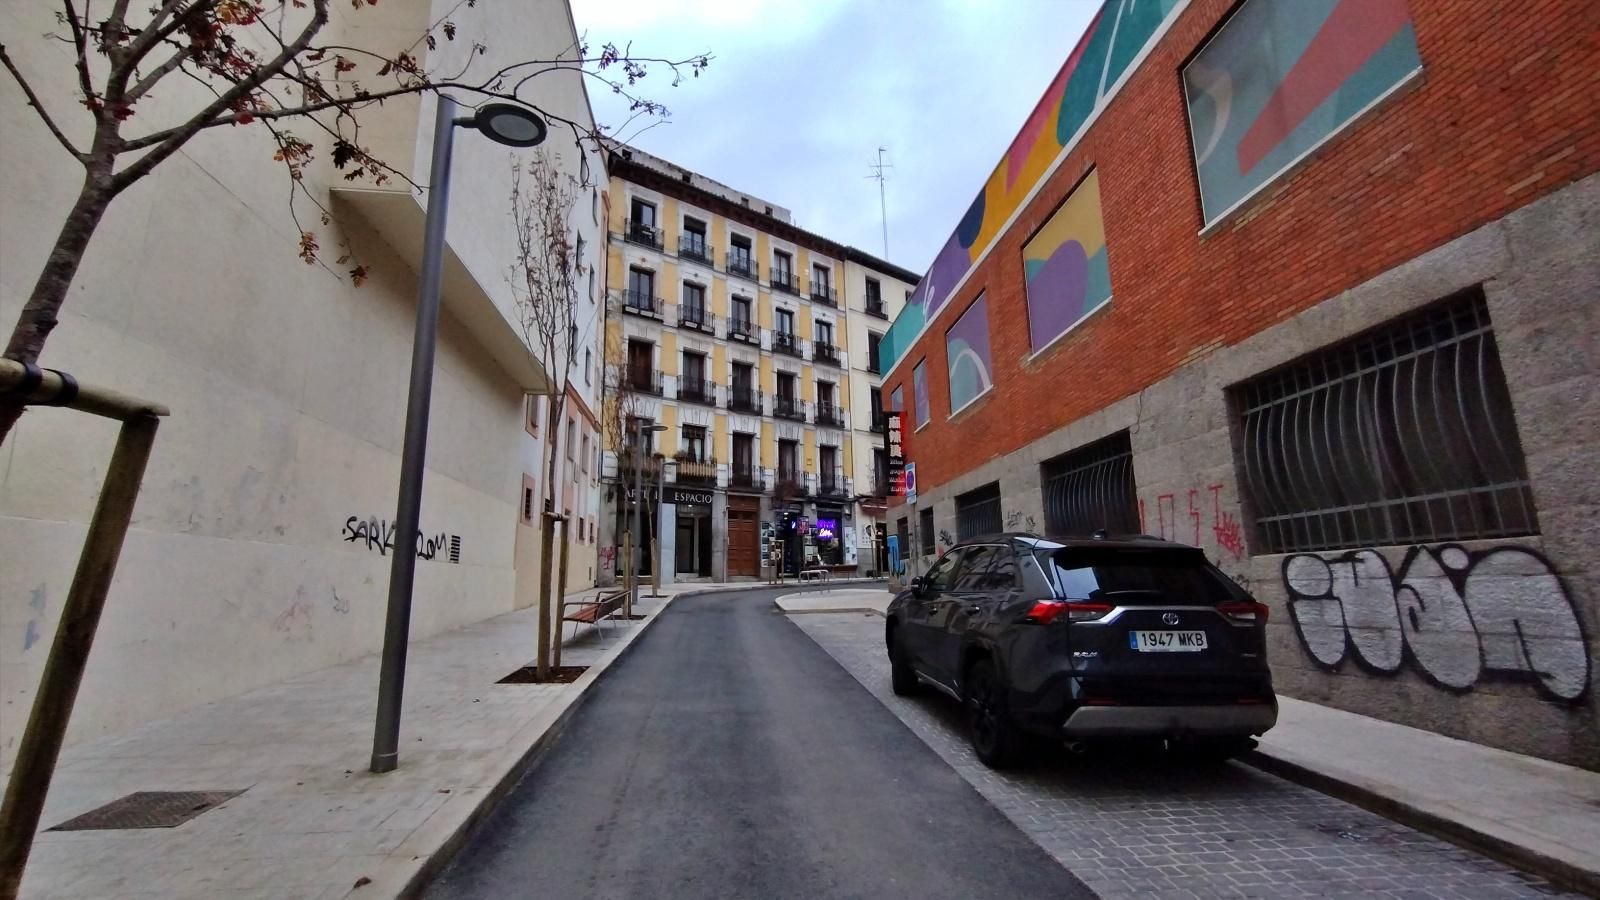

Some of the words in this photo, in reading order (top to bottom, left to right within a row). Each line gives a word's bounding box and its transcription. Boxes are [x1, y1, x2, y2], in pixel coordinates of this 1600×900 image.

[674, 491, 713, 505] ESPACIO
[1141, 632, 1175, 648] 1947
[1177, 632, 1205, 648] MKB
